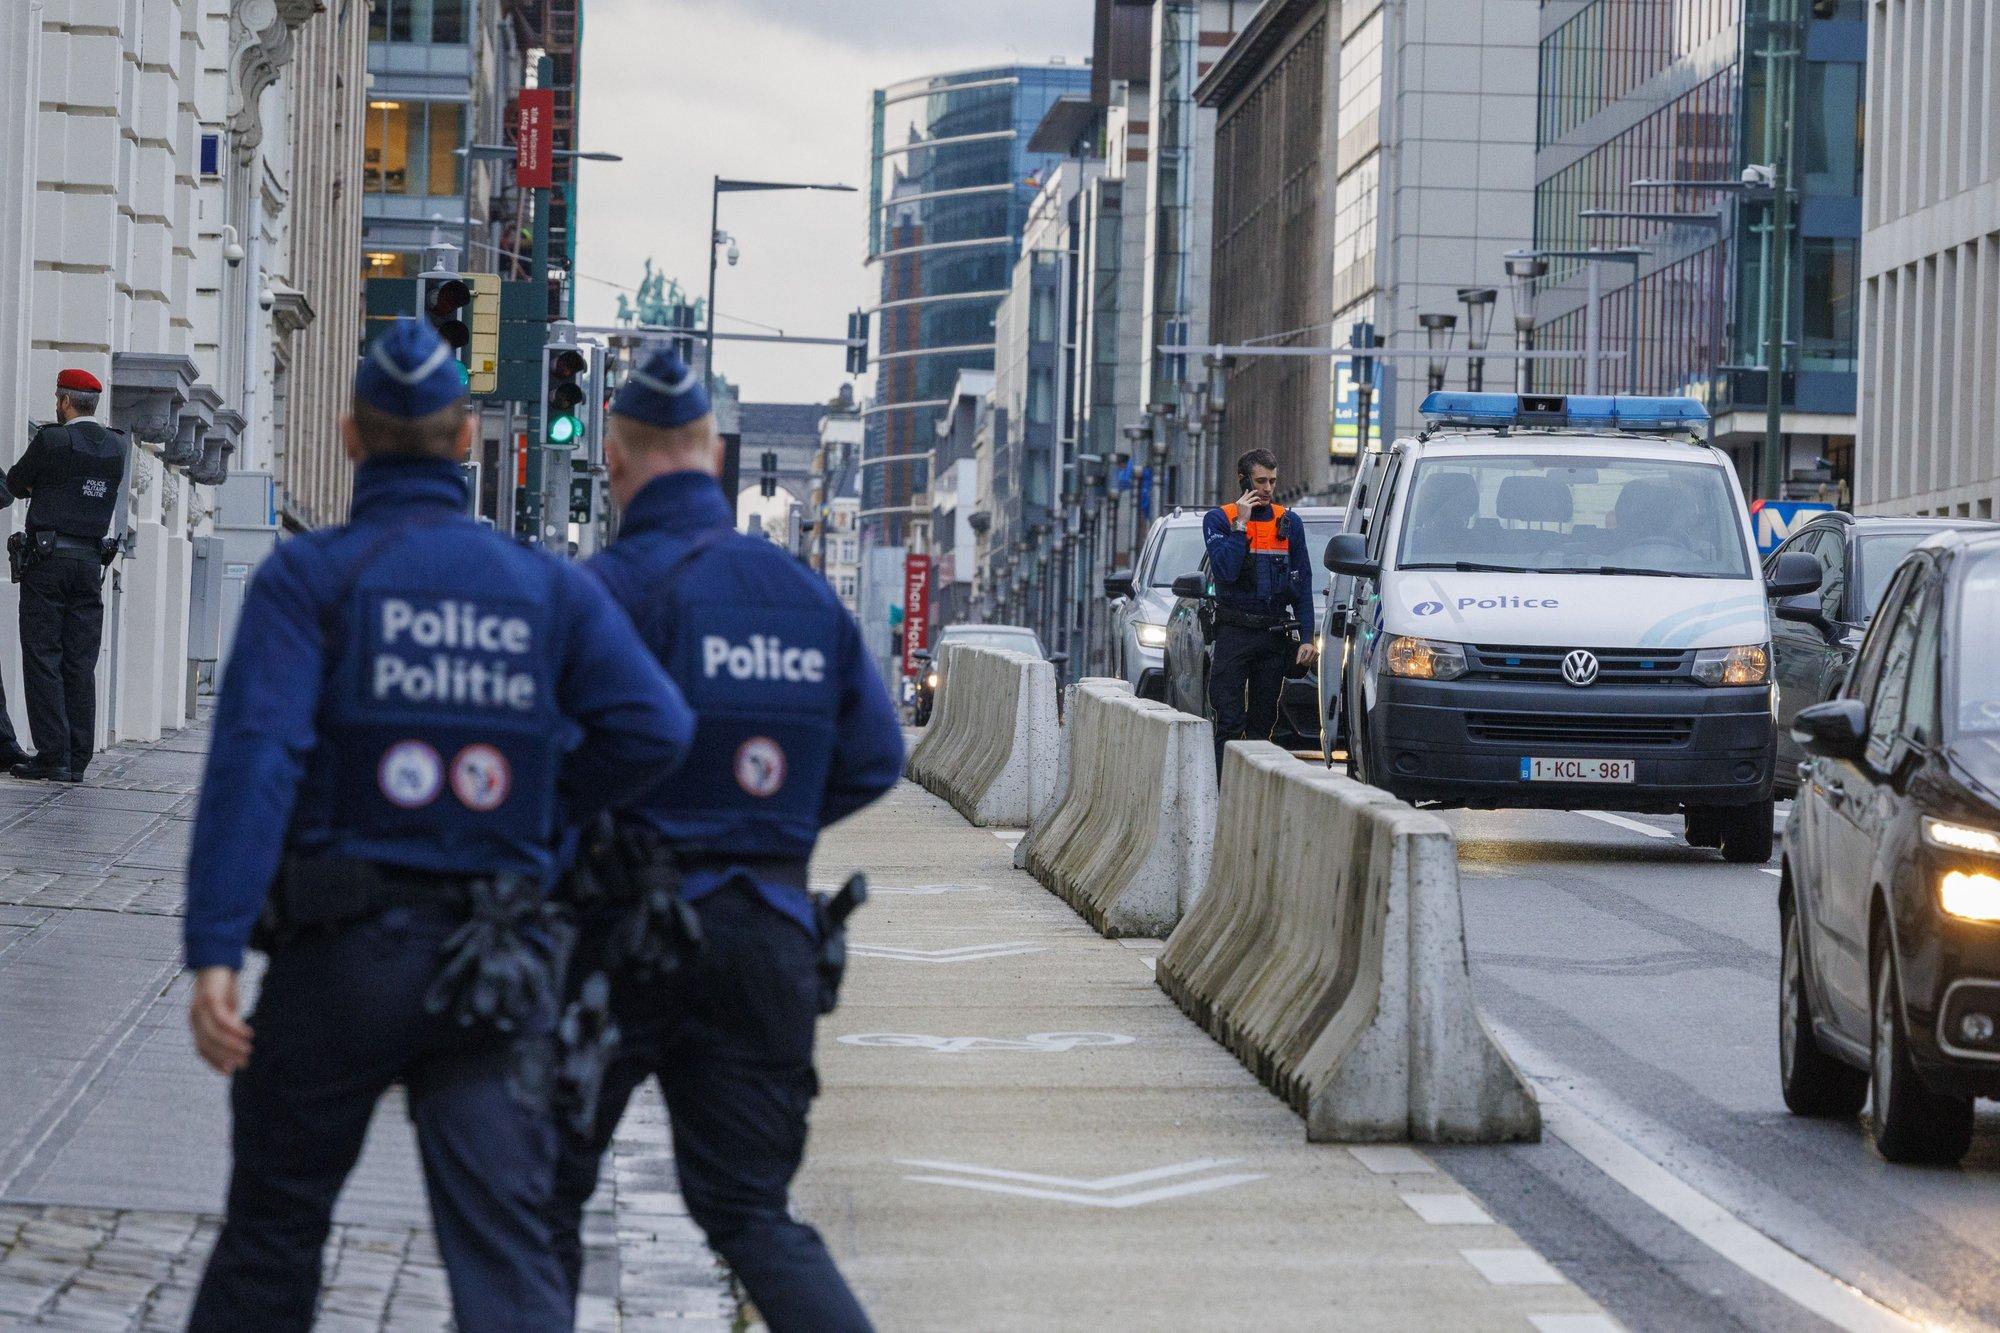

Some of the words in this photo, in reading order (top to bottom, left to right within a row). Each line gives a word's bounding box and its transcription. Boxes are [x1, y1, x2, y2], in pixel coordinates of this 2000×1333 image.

[909, 571, 926, 613] Thon
[1457, 595, 1560, 611] Police
[382, 599, 532, 654] Police
[702, 633, 826, 682] Police
[374, 653, 536, 710] Politie
[1534, 760, 1630, 780] 1-KCL-981
